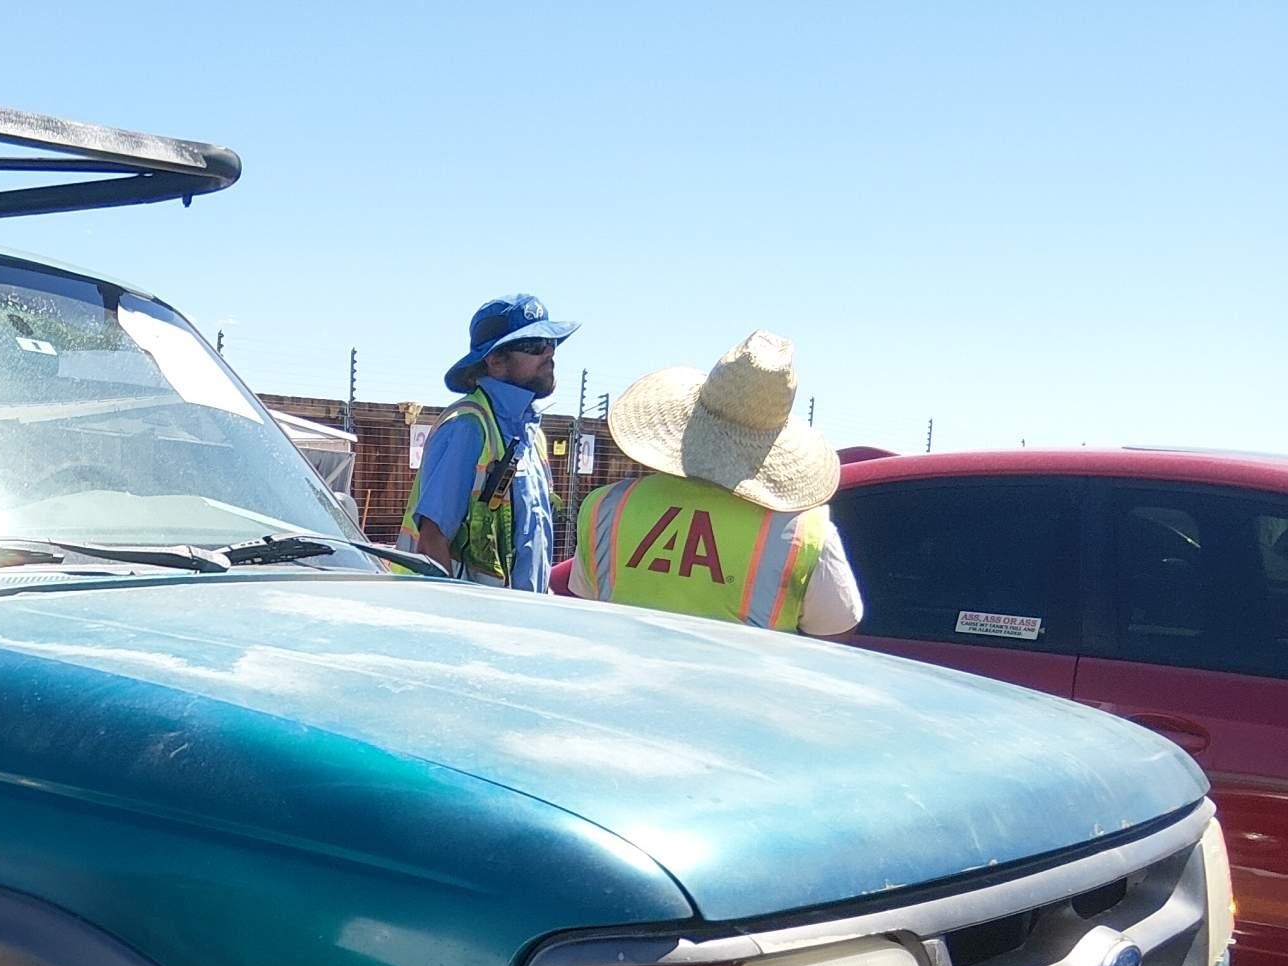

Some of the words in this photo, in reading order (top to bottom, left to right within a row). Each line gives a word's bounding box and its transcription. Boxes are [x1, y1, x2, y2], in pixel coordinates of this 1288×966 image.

[983, 615, 1001, 624] ASS
[1003, 617, 1018, 626] OR
[1019, 619, 1037, 627] ASS
